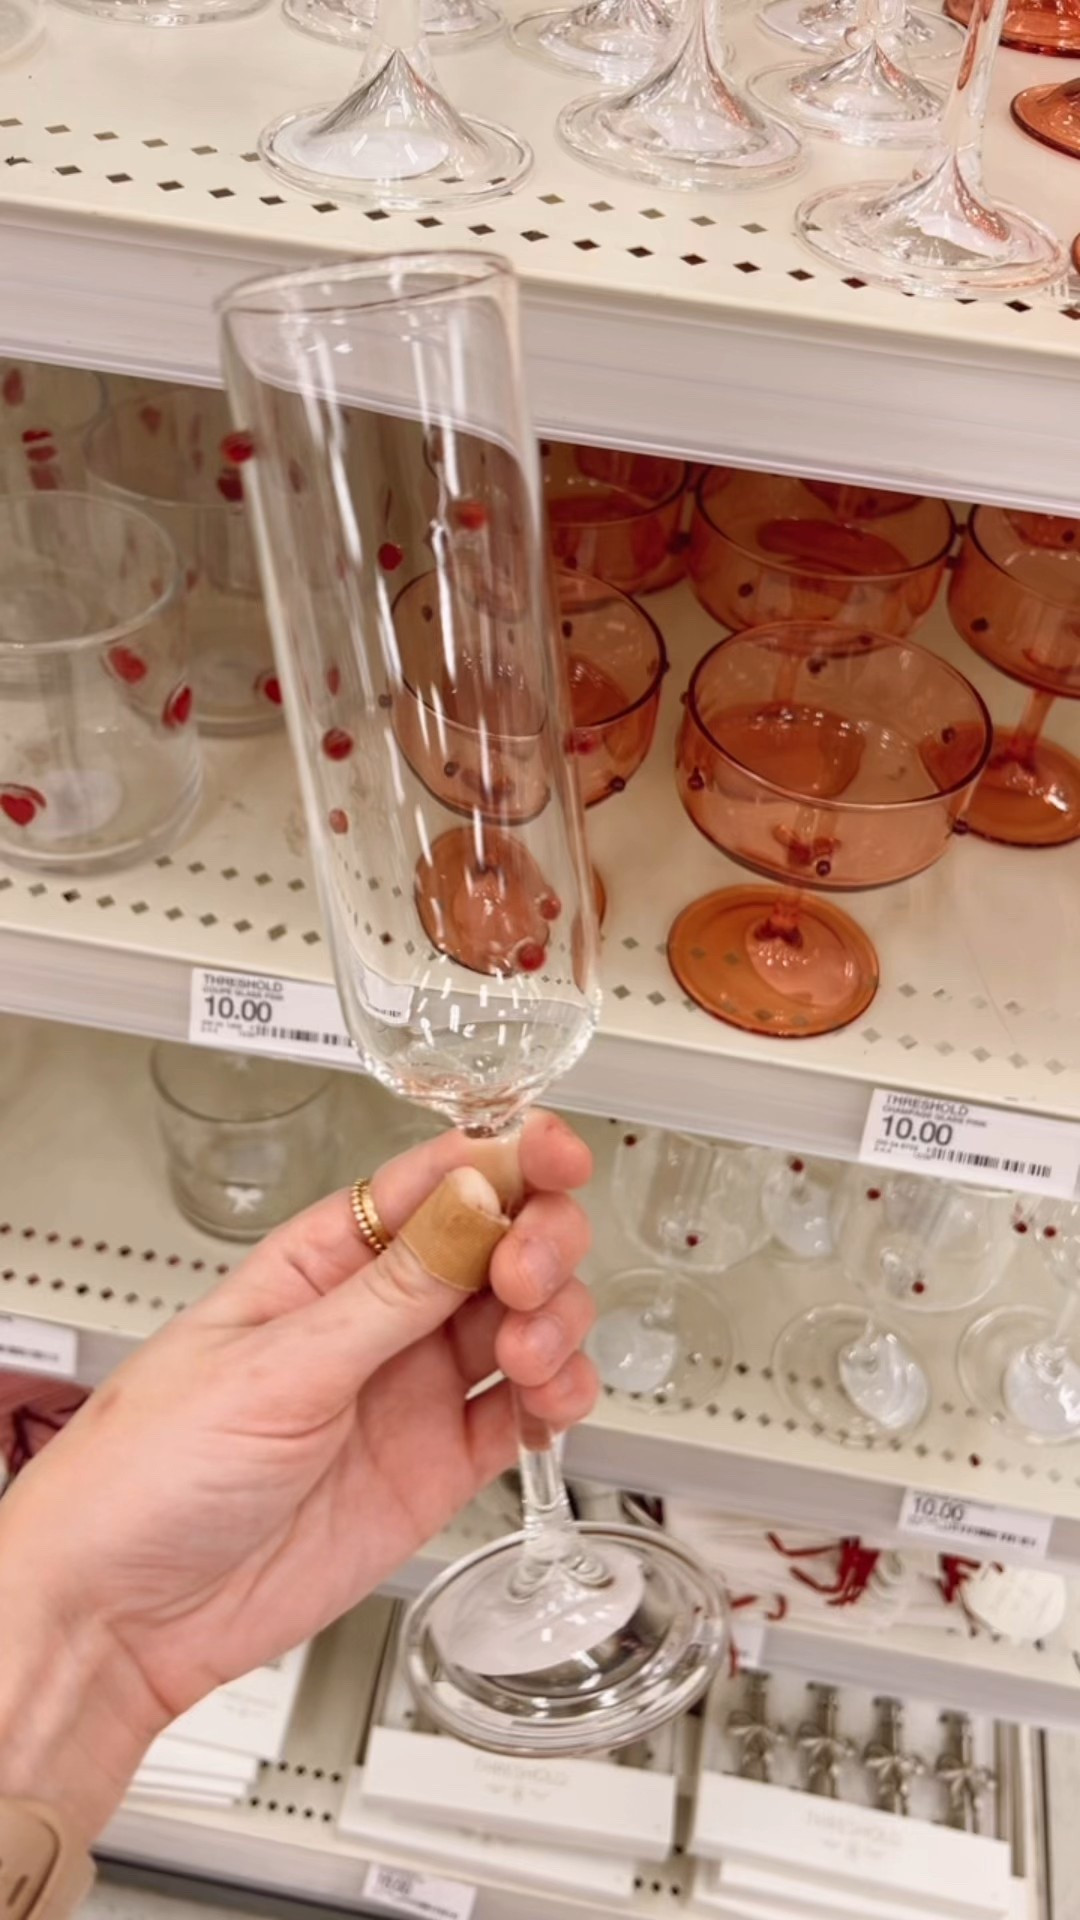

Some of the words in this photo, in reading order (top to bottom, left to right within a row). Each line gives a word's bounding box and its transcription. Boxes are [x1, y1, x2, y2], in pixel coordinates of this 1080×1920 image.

[203, 973, 284, 992] THRESHOLD
[204, 996, 272, 1023] 10.00
[886, 1093, 970, 1116] THRESHOLD
[882, 1115, 953, 1146] 10.00
[914, 1496, 965, 1522] 10.00
